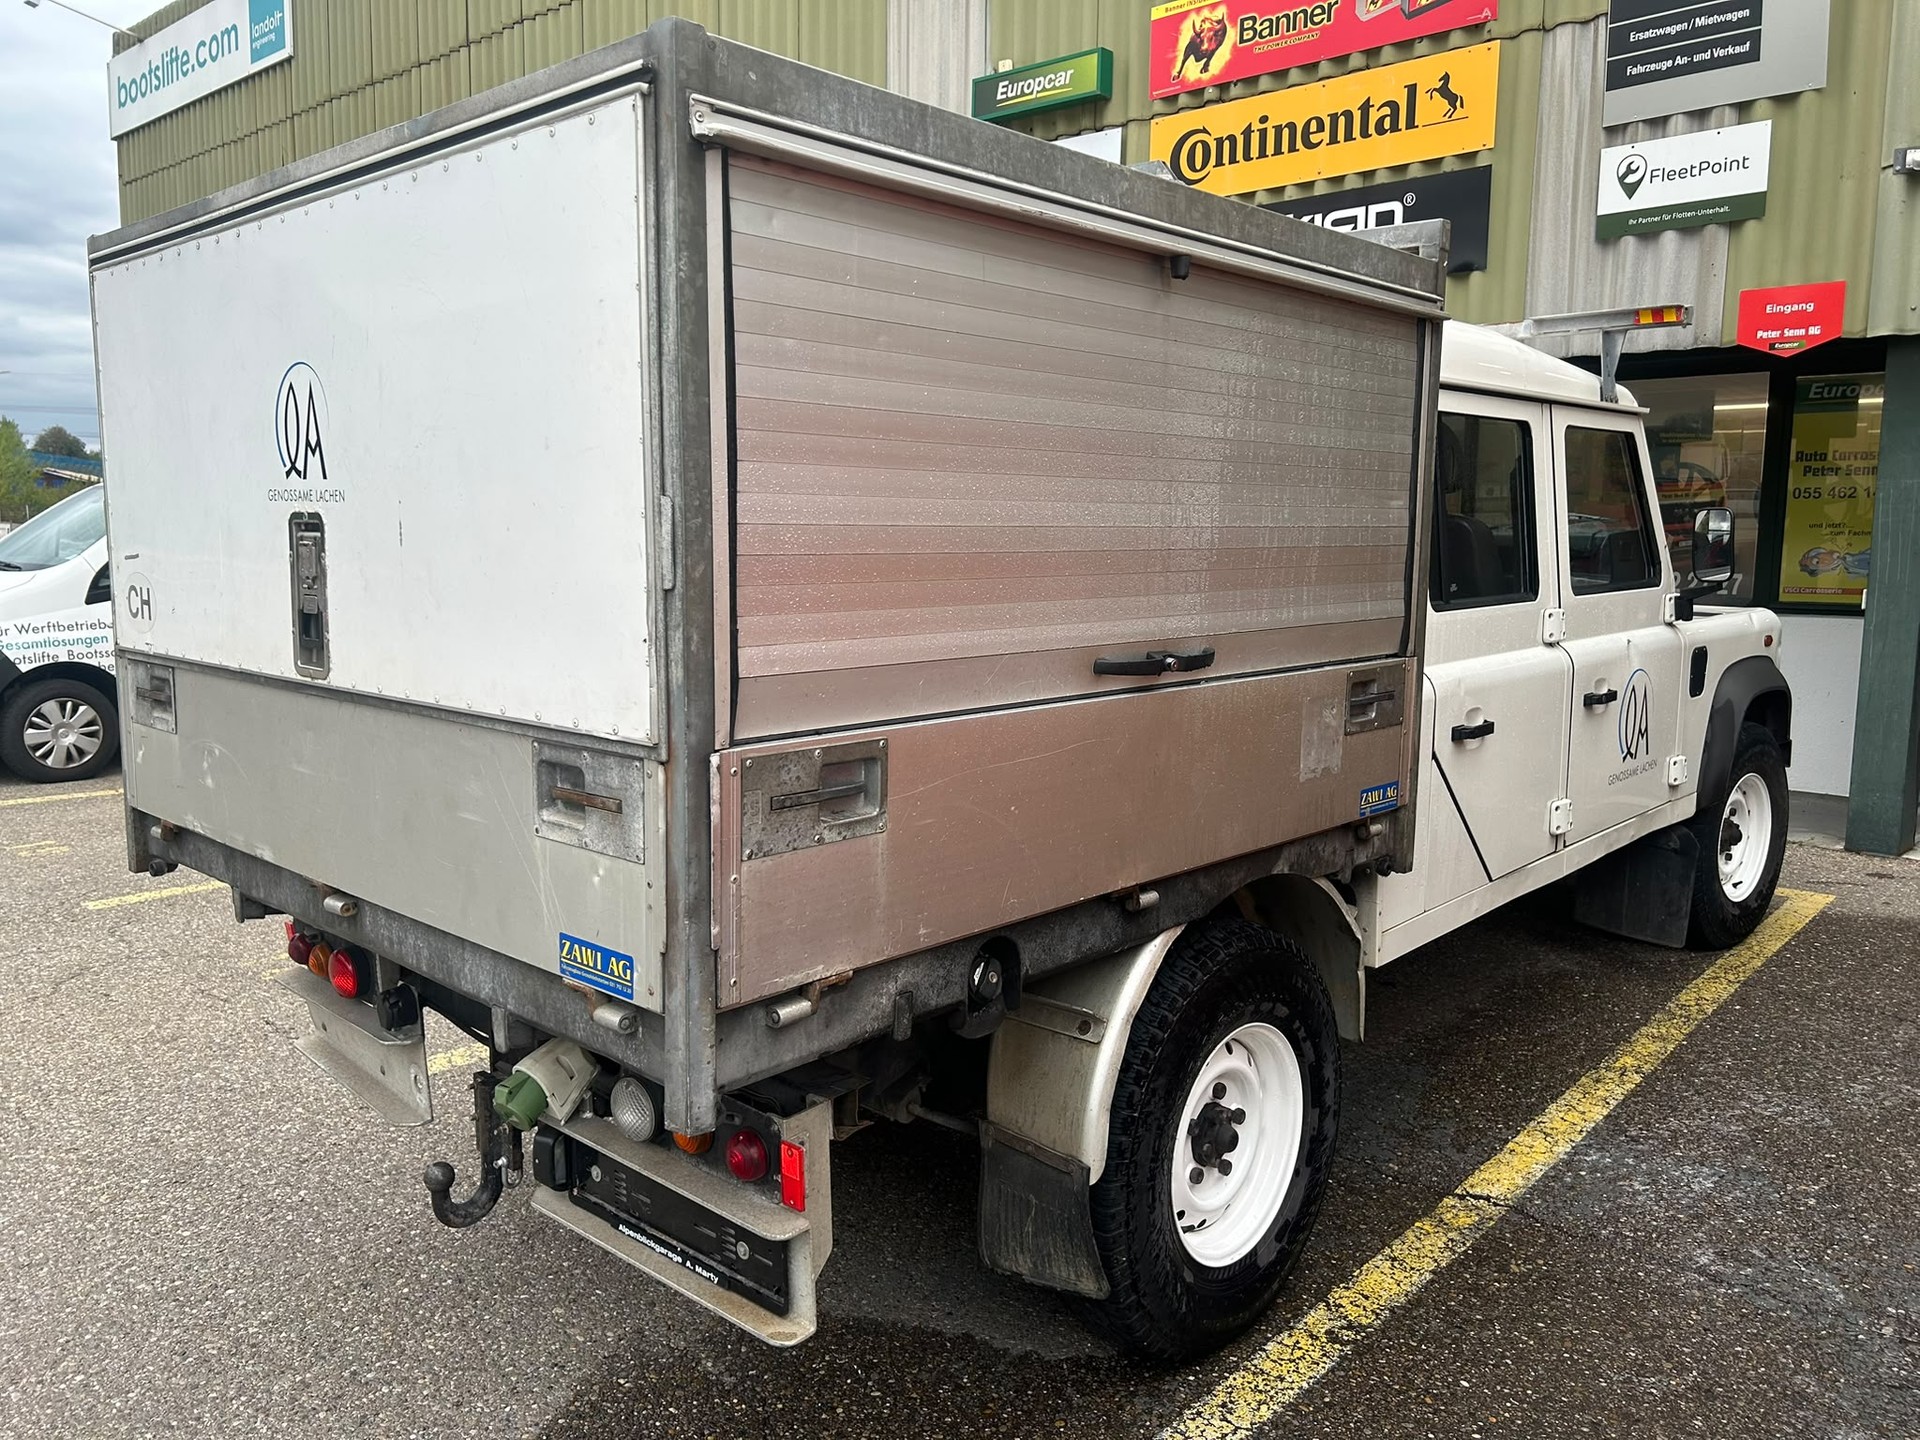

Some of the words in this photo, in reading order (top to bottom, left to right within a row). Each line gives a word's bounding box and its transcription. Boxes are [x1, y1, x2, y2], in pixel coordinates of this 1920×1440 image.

[251, 10, 283, 39] landolt
[1238, 0, 1339, 45] Banner
[1629, 22, 1688, 42] Ersatzwagen
[1695, 8, 1750, 28] Mietwagen
[1266, 40, 1288, 51] POWER
[1289, 32, 1320, 46] COMPANY
[117, 23, 239, 109] bootslifte.com
[1626, 60, 1673, 76] Fahrzeuge
[1674, 55, 1692, 66] An-
[1693, 50, 1711, 62] und
[1713, 41, 1751, 58] Verkauf
[996, 69, 1074, 100] Europcar
[1170, 83, 1418, 186] Continental
[1649, 156, 1750, 184] FleetPoint
[1638, 215, 1661, 224] Partner
[1662, 213, 1672, 221] für
[1765, 302, 1815, 314] Eingang
[1756, 330, 1781, 339] Peter
[1783, 328, 1806, 337] Senn
[1808, 325, 1821, 335] AG
[1795, 451, 1828, 462] Auto
[1832, 449, 1880, 461] Carros
[1803, 465, 1841, 477] Peter
[267, 488, 313, 502] GENOSSAME
[315, 489, 346, 503] LACHEN
[1792, 487, 1822, 499] 055
[1827, 486, 1857, 499] 462
[1863, 486, 1876, 499] 1
[127, 584, 152, 621] CH
[1360, 788, 1383, 805] ZAWI
[1386, 785, 1397, 798] AG
[560, 939, 602, 970] ZAWI
[607, 956, 631, 981] AG
[618, 1223, 683, 1263] Alpenblickgarage
[685, 1260, 694, 1270] A.
[695, 1264, 719, 1285] Marty
